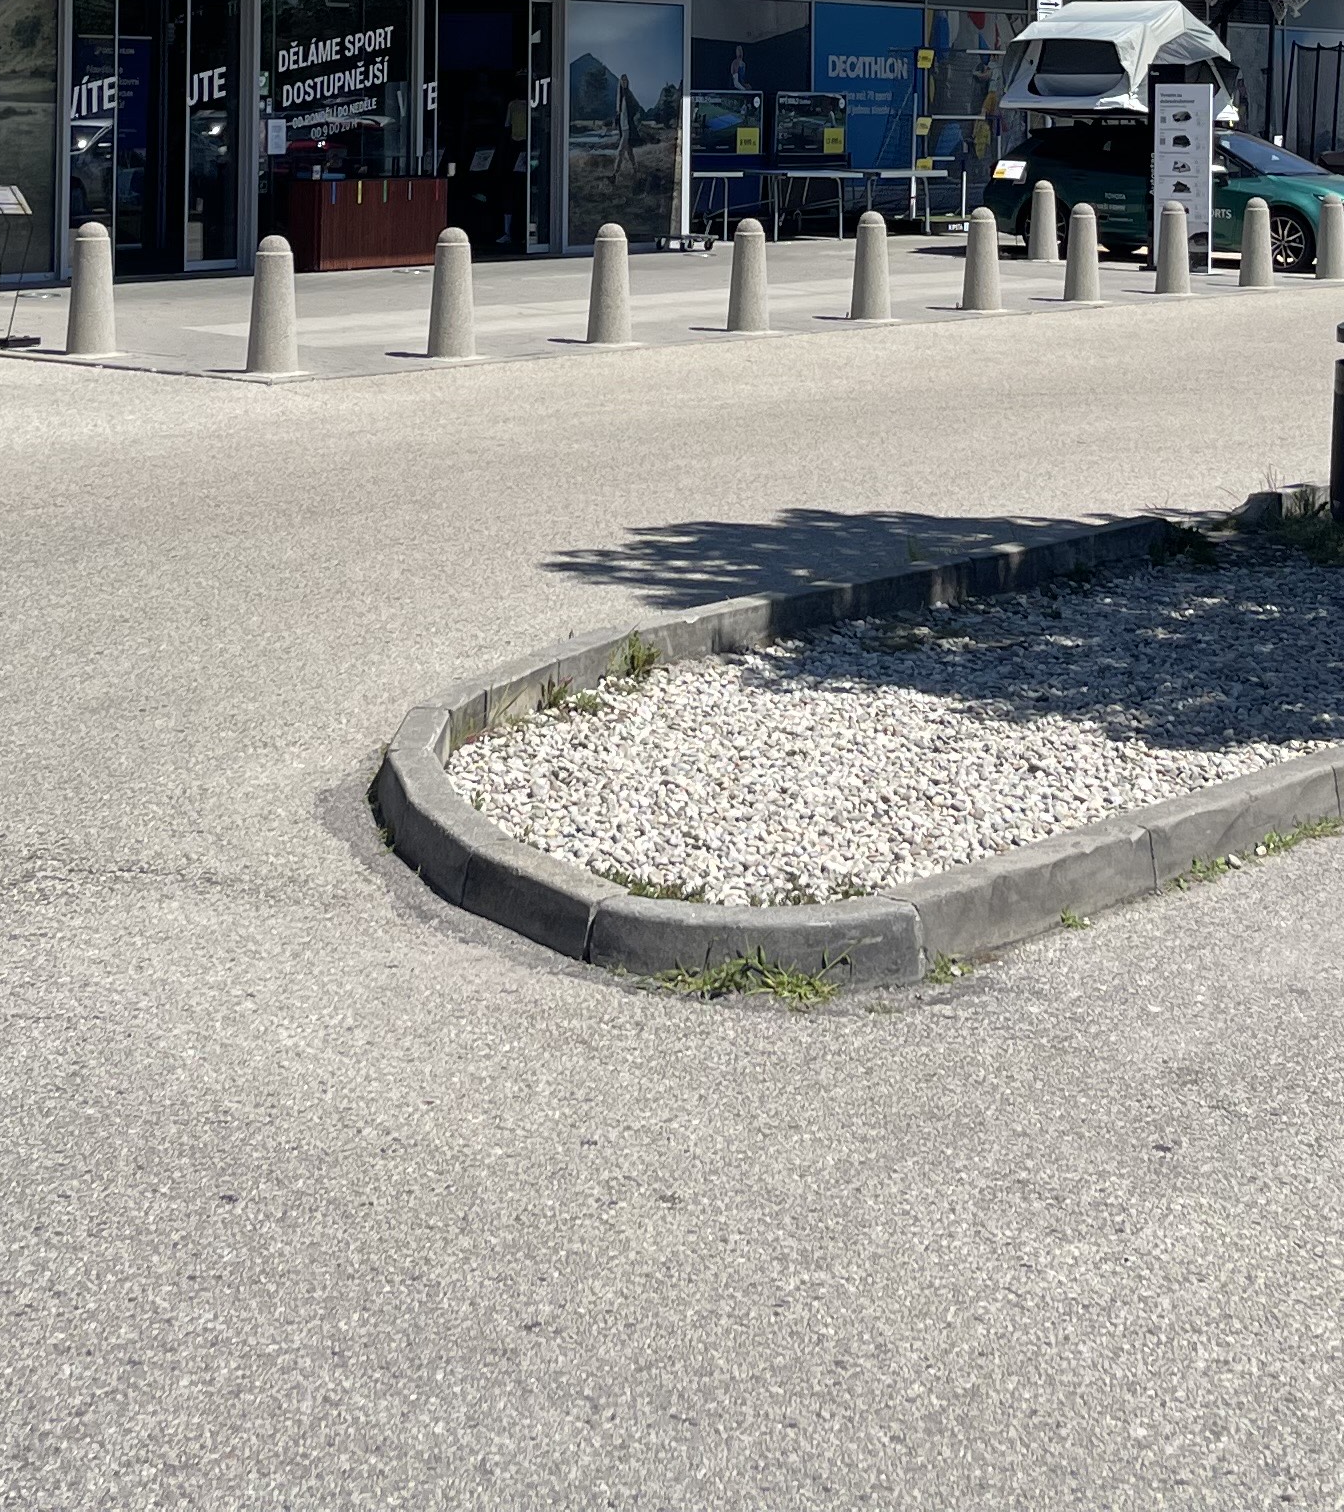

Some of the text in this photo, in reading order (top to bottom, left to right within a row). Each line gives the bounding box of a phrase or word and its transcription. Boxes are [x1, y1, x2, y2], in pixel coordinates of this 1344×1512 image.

[278, 26, 394, 73] DĚLÁME SPORT
[828, 55, 909, 80] DECATHLON
[282, 55, 389, 107] DOSTUPNĚJŠÍ
